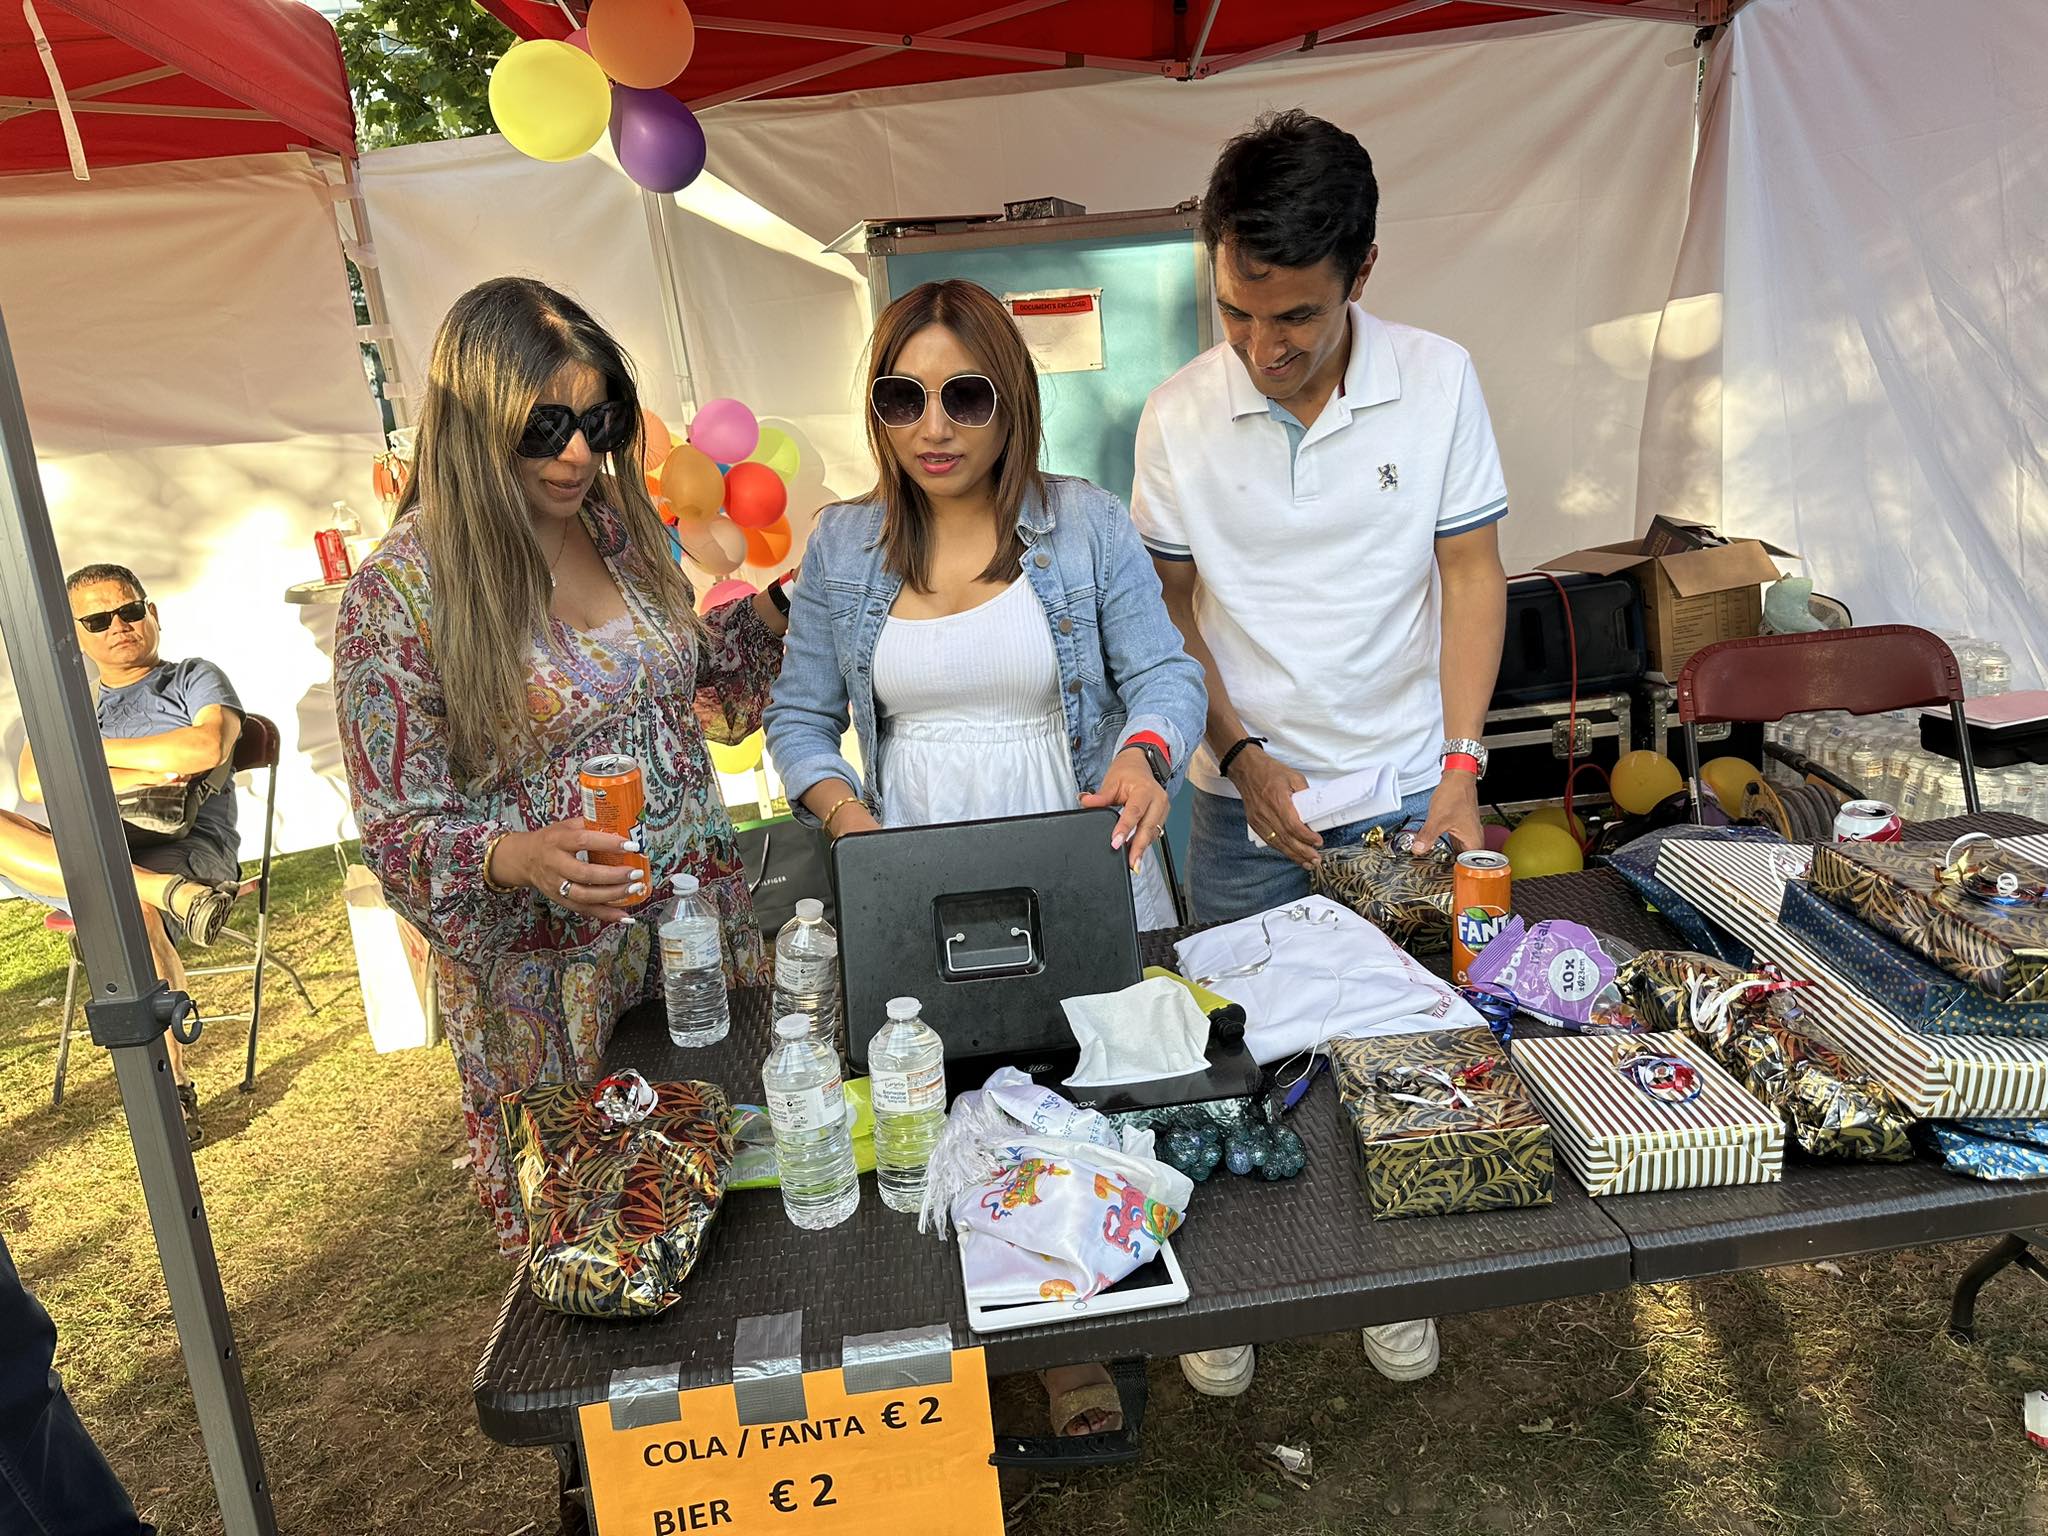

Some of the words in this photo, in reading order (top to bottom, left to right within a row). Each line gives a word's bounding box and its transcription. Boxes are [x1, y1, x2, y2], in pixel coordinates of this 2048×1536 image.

[1019, 303, 1056, 311] DOCUMENTS
[1057, 301, 1087, 309] ENCLOSED
[1457, 913, 1510, 943] FANT
[1562, 958, 1575, 993] 10x
[643, 1436, 728, 1467] COLA
[737, 1429, 750, 1459] /
[761, 1415, 866, 1449] FANTA
[880, 1401, 907, 1429] €
[918, 1396, 943, 1424] 2
[653, 1498, 733, 1536] BIER
[769, 1479, 798, 1513] €
[810, 1473, 837, 1507] 2
